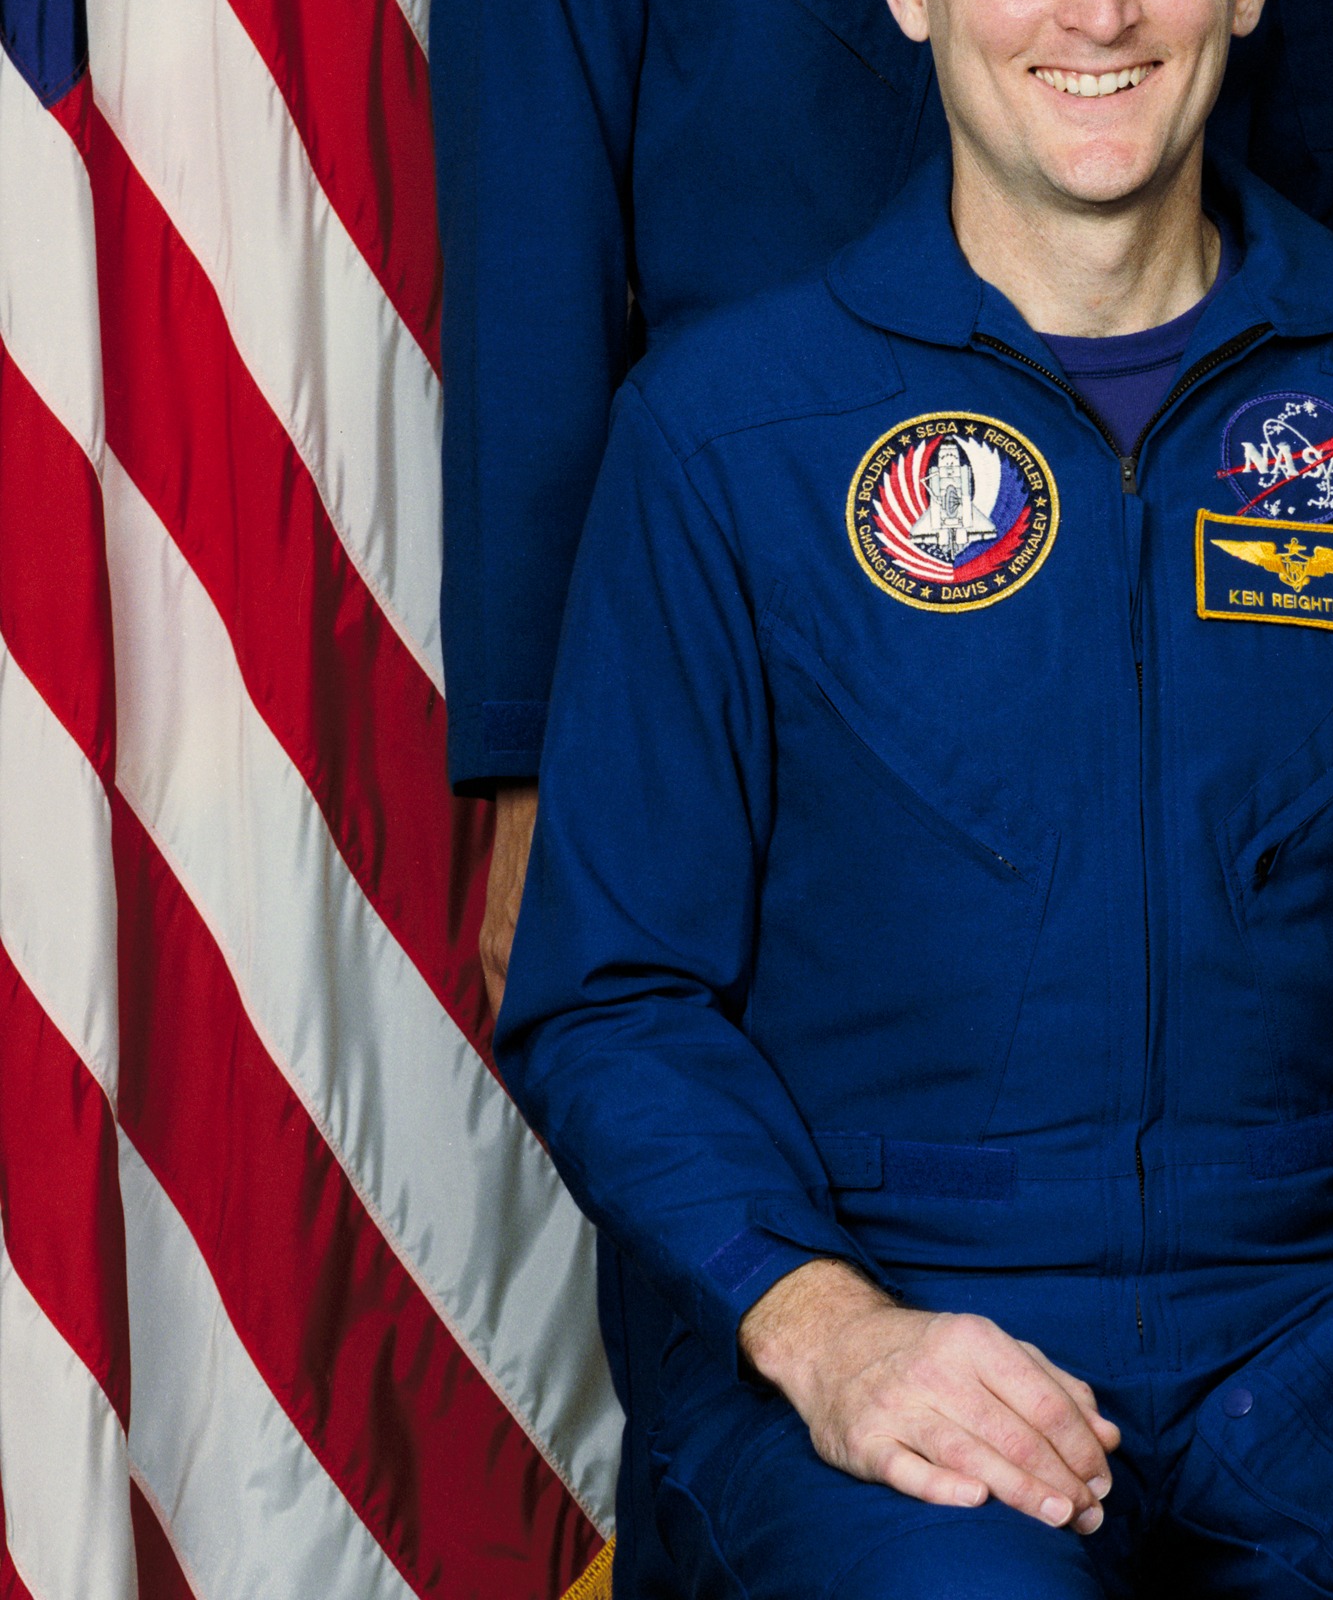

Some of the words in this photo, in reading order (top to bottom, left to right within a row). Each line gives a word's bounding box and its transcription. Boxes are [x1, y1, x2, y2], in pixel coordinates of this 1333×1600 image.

[858, 446, 896, 501] BOLDEN
[916, 421, 958, 438] SEGA
[983, 428, 1044, 491] REIGHTLER
[859, 525, 917, 594] CHANG-DÍAZ
[941, 581, 988, 600] DAVIS
[1008, 512, 1047, 575] KRIKALEV
[1229, 589, 1264, 607] KEN
